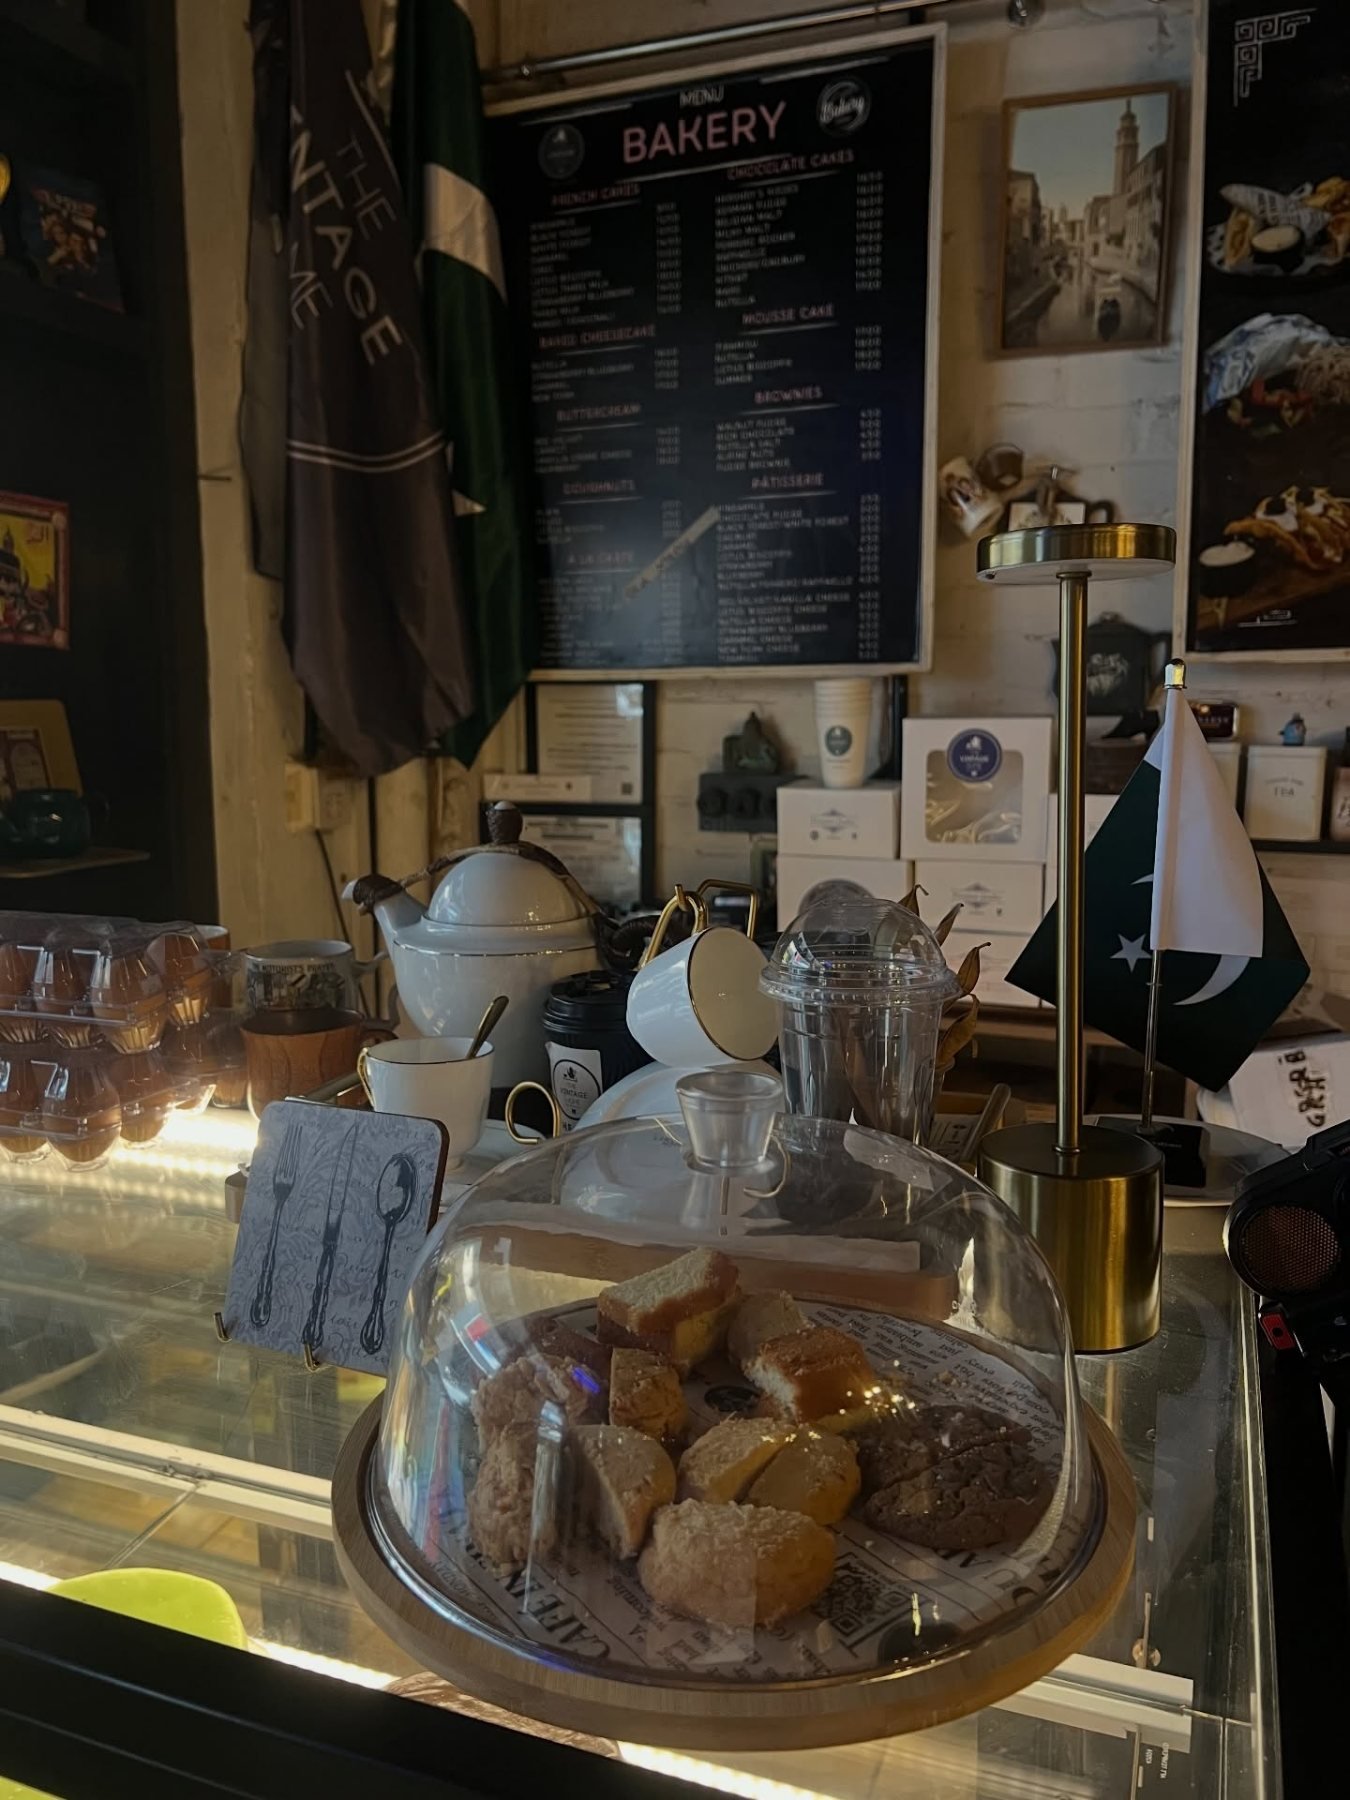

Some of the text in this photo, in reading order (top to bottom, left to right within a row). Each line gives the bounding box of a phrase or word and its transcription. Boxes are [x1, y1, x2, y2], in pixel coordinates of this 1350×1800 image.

[680, 85, 725, 108] MENU
[622, 100, 787, 164] BAKERY
[810, 148, 856, 168] CAKES
[337, 136, 397, 240] THE
[290, 104, 402, 366] NTAGE
[742, 308, 796, 325] MOUSSE
[754, 385, 823, 404] BROWNIES
[523, 1591, 608, 1659] CAFE
